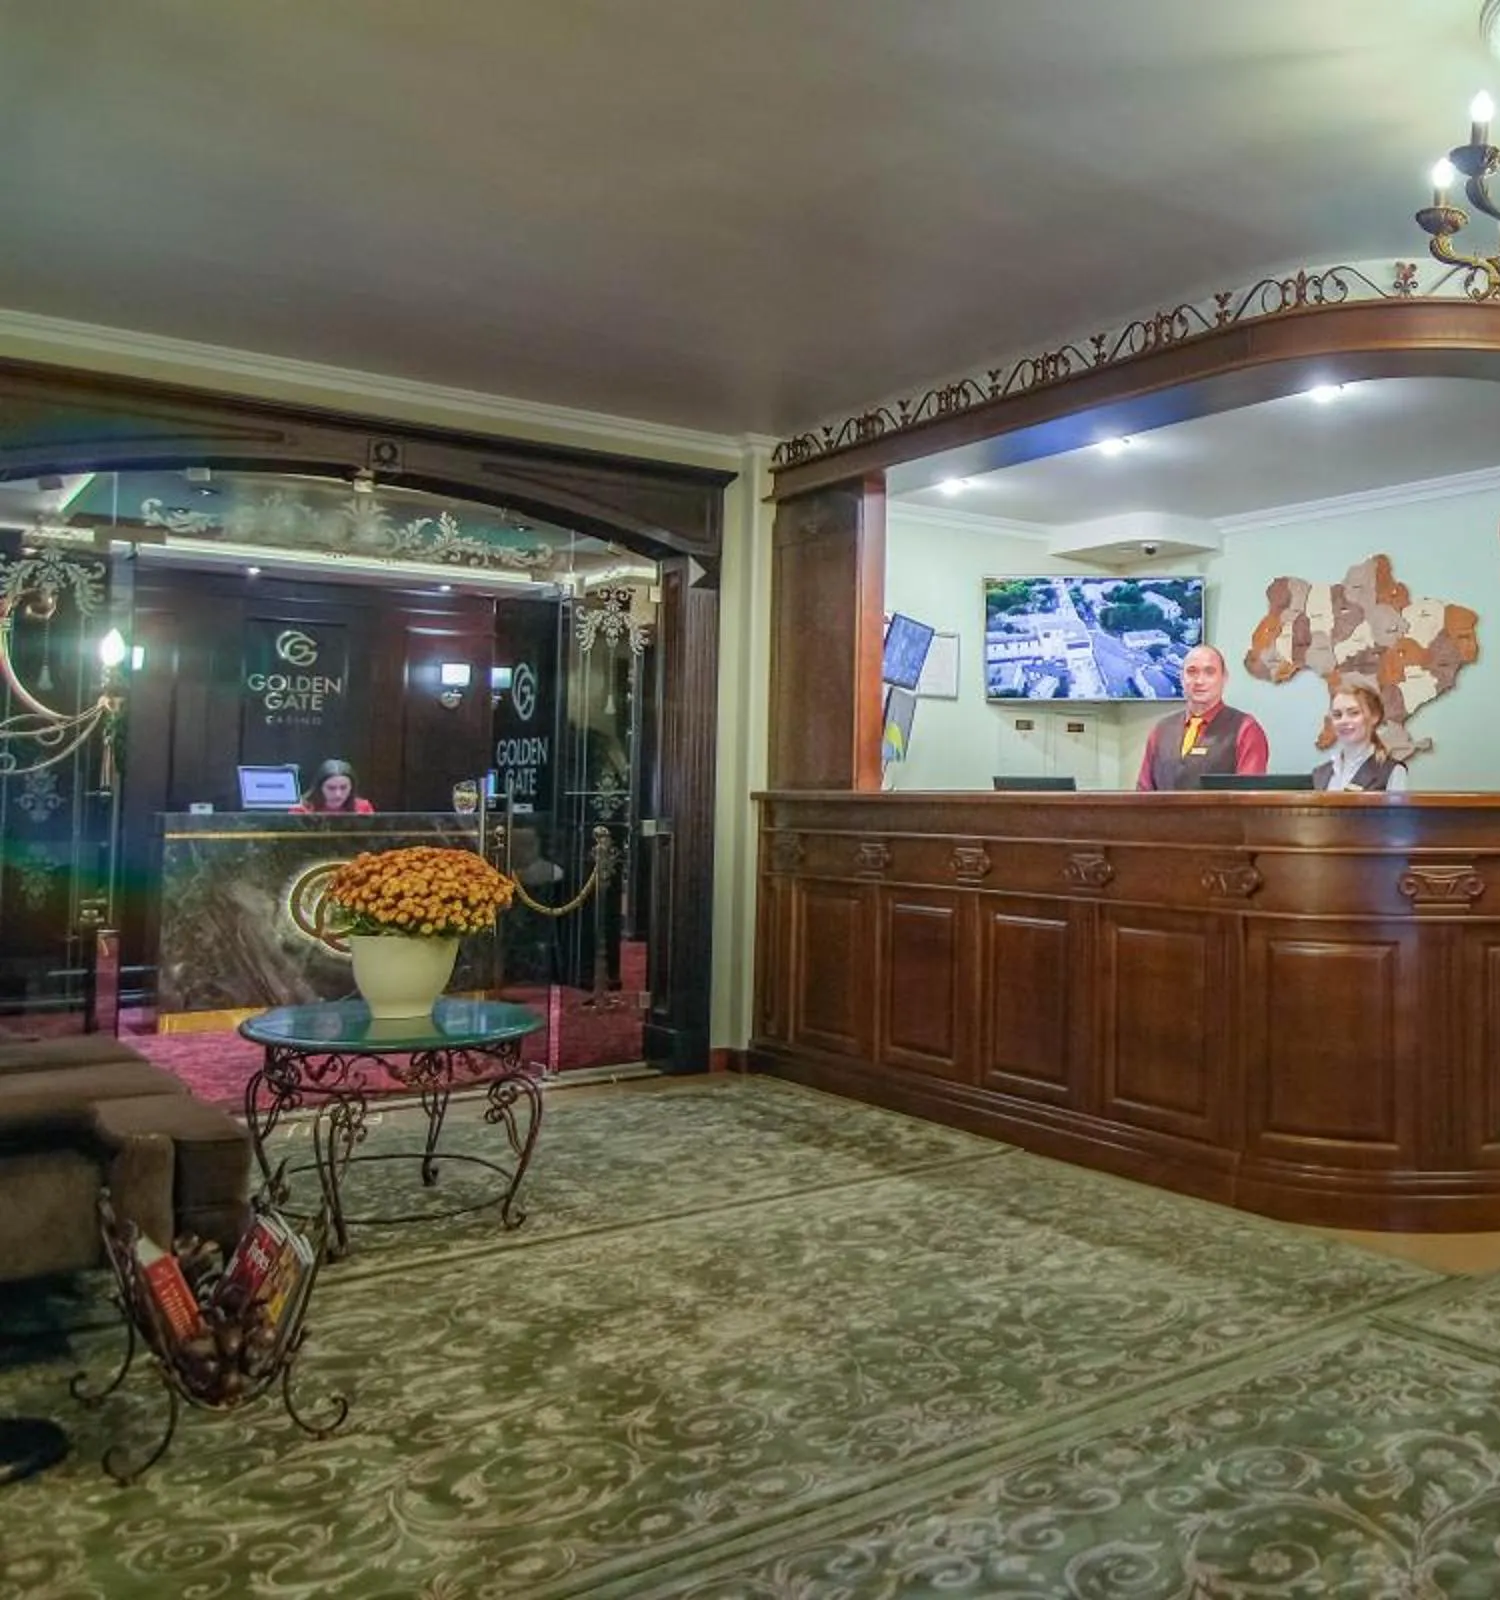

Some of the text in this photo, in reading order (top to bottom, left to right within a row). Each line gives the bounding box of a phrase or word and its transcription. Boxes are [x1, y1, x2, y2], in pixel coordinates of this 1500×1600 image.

[247, 673, 342, 694] GOLDEN
[265, 692, 324, 711] GATE
[496, 737, 549, 766] GOLDEN
[504, 766, 537, 795] GATE
